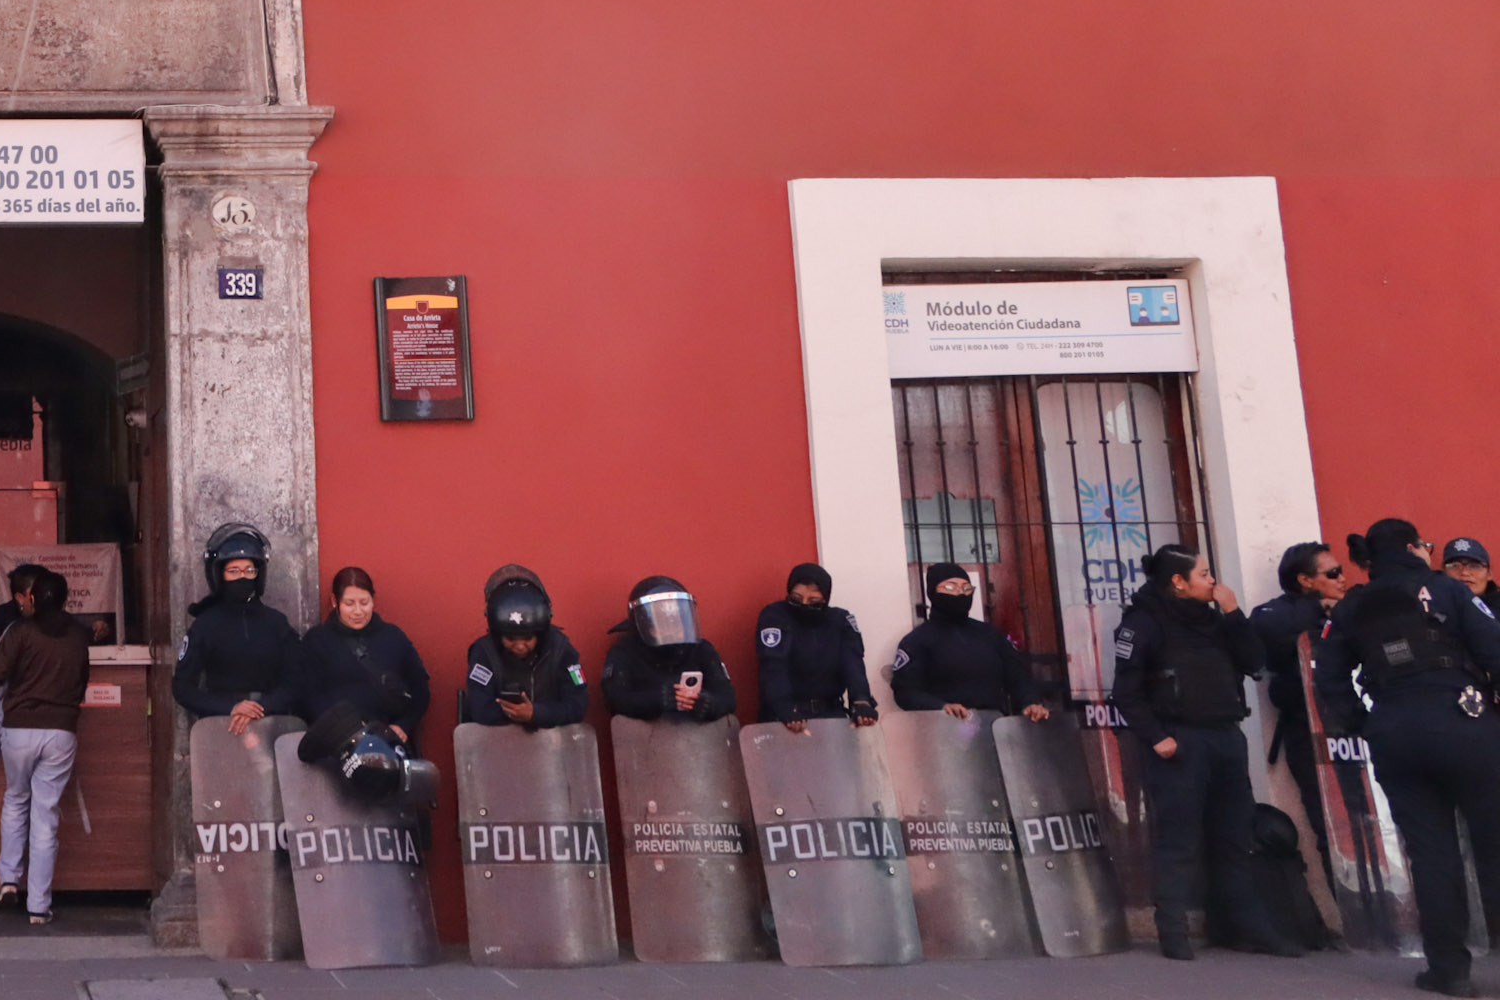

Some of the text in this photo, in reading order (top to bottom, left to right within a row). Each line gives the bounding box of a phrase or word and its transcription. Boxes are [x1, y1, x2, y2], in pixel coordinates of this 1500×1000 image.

[30, 145, 58, 164] 00
[25, 170, 65, 190] 201
[73, 170, 99, 190] 01
[107, 170, 135, 190] 05
[2, 199, 33, 213] 365
[37, 198, 71, 213] días
[76, 198, 100, 213] del
[105, 199, 141, 213] año.
[225, 272, 256, 296] 339
[926, 300, 1018, 317] Módulo de
[884, 318, 909, 328] CDH
[927, 318, 1081, 332] Videoatención Ciudadana
[1084, 588, 1135, 600] PUEB
[1085, 704, 1128, 727] POLI
[1326, 736, 1366, 761] POLI
[196, 821, 290, 853] OLICIA
[634, 823, 741, 837] POLICIA ESTATAL
[907, 821, 1012, 834] POLICIA ESTATAL
[1022, 812, 1101, 854] POLIC
[296, 826, 419, 867] POLICIA
[469, 825, 602, 861] POLICIA
[635, 839, 743, 853] PREVENTIVA PUEBLA
[765, 820, 898, 861] POLICIA
[910, 838, 1016, 852] PREVENTIVA PUEBLA
